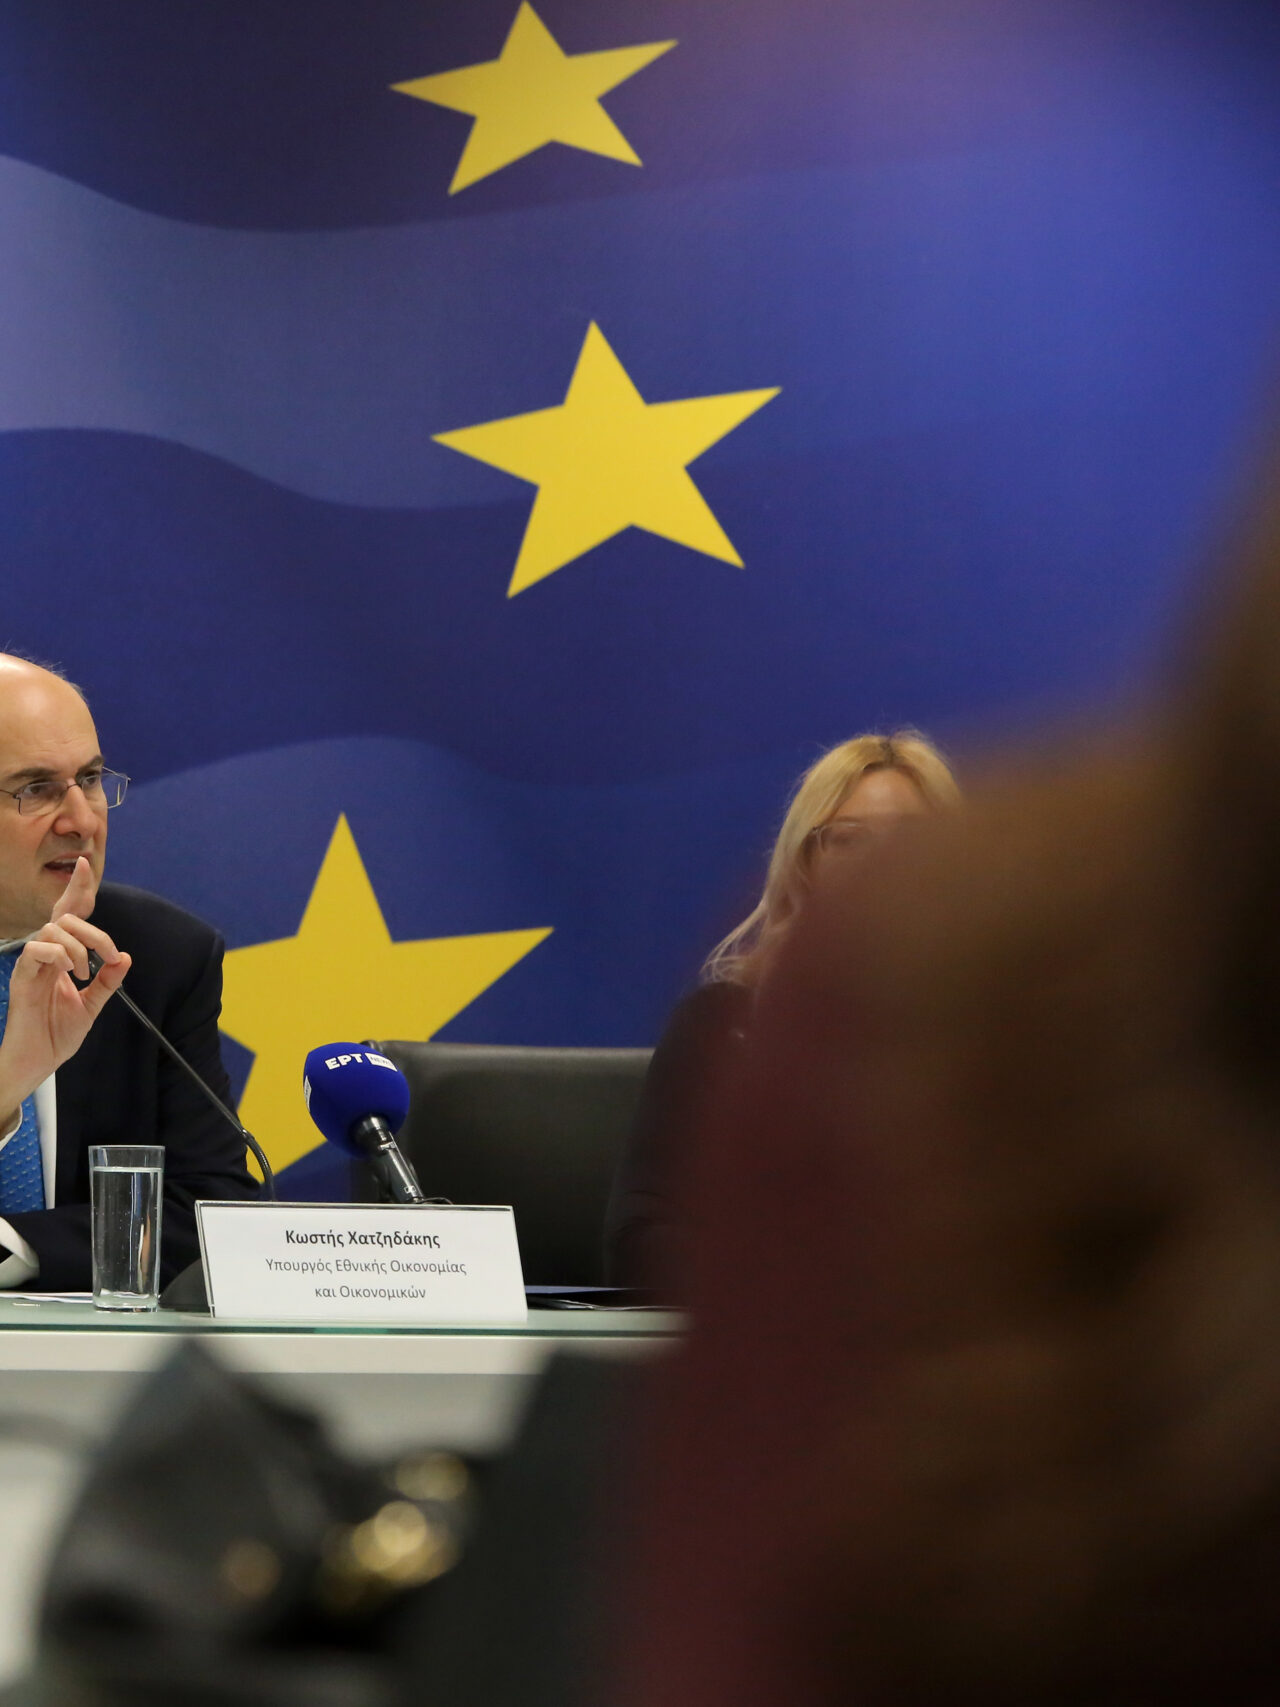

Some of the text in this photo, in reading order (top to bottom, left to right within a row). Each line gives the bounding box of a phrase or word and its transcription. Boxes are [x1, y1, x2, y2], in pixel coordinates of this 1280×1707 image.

[285, 1229, 441, 1249] Κωστής Χατζηδάκης
[265, 1258, 467, 1276] Υπουργός Εθνικής Οικονομίας
[314, 1284, 426, 1301] και Οικονομικών
